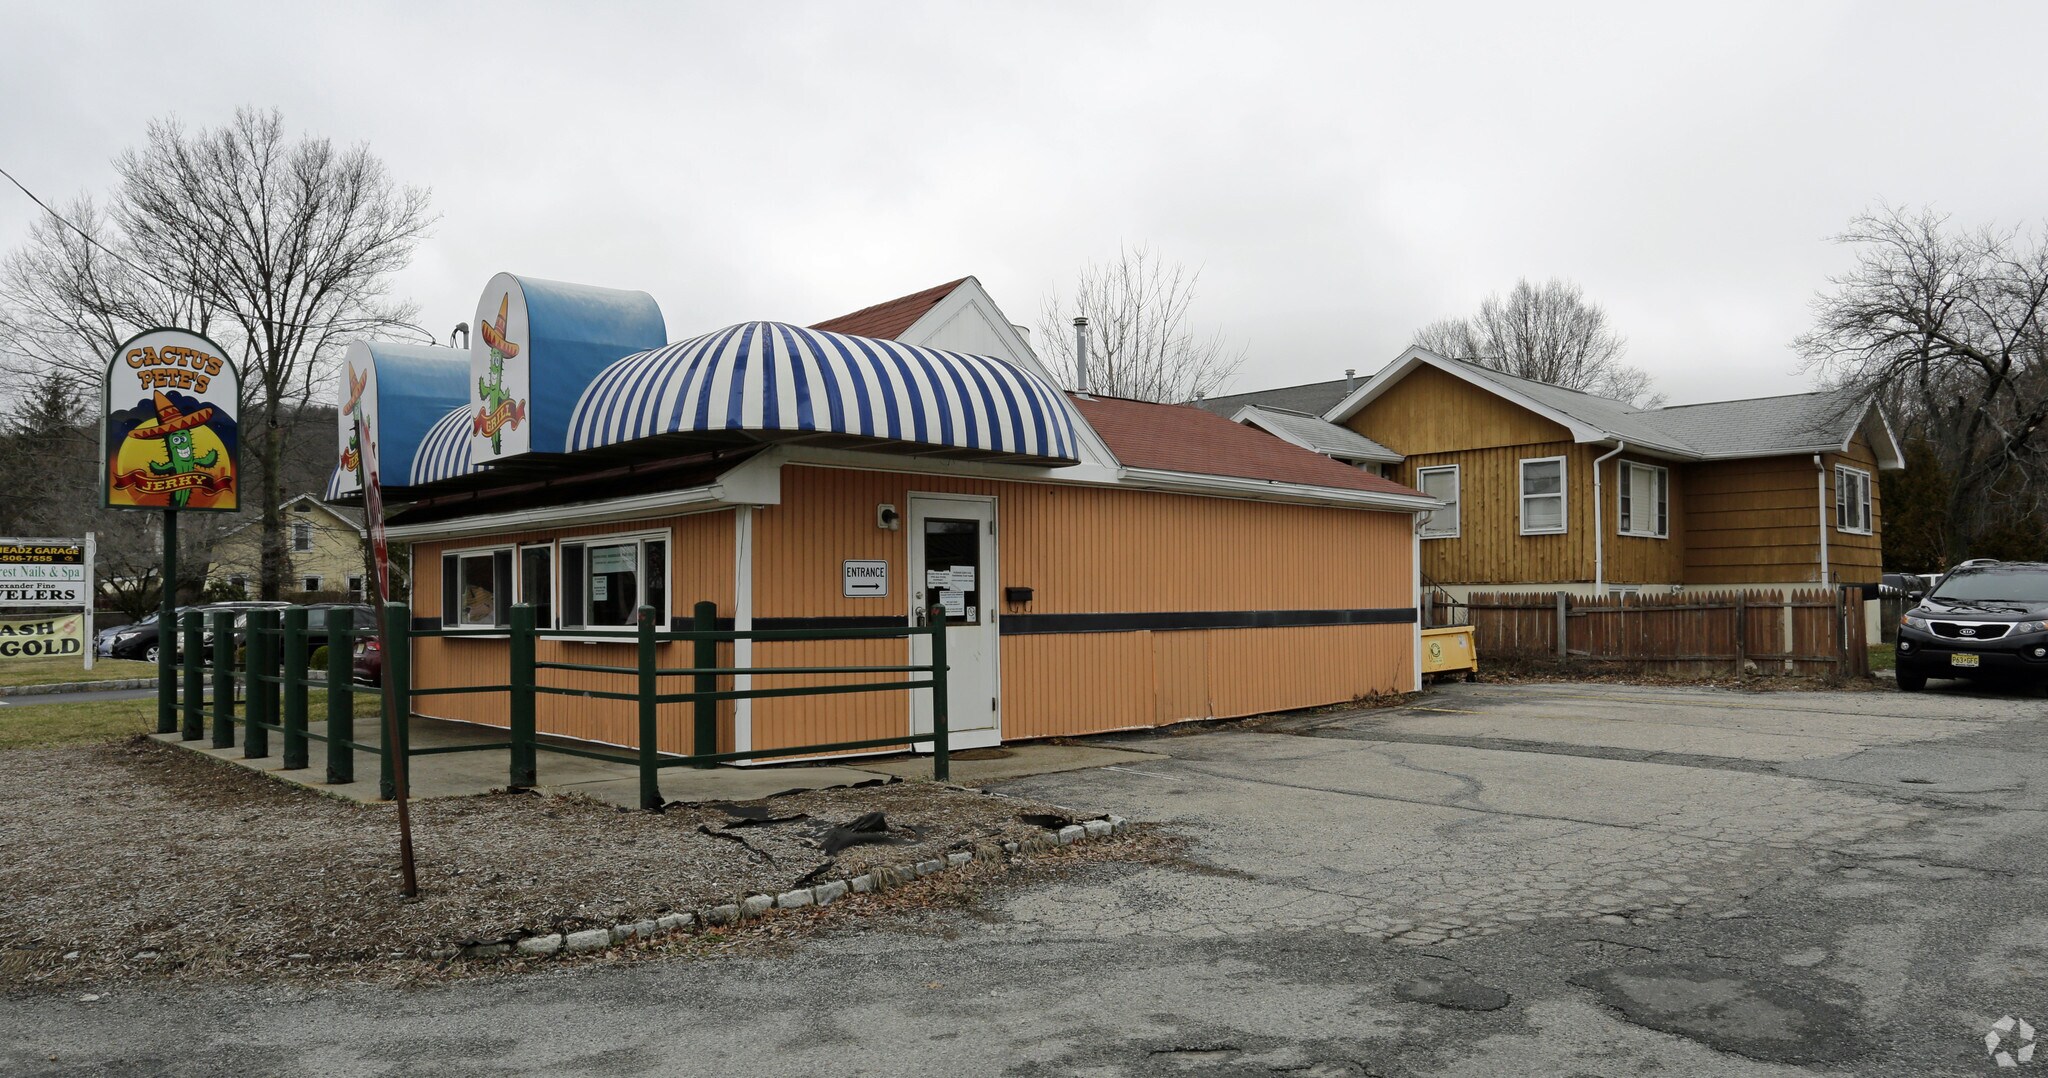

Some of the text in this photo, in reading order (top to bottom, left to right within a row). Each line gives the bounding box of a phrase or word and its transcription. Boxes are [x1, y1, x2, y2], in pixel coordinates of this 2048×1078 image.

[126, 345, 224, 376] CACTUS
[137, 368, 211, 394] PETE'S
[486, 404, 511, 432] GRILL
[142, 476, 206, 490] JERKY
[35, 547, 79, 555] GARAGE
[21, 566, 46, 577] Nails
[49, 566, 58, 577] &
[62, 566, 80, 581] Spa
[847, 567, 884, 577] ENTRANCE
[0, 638, 80, 656] GOLD
